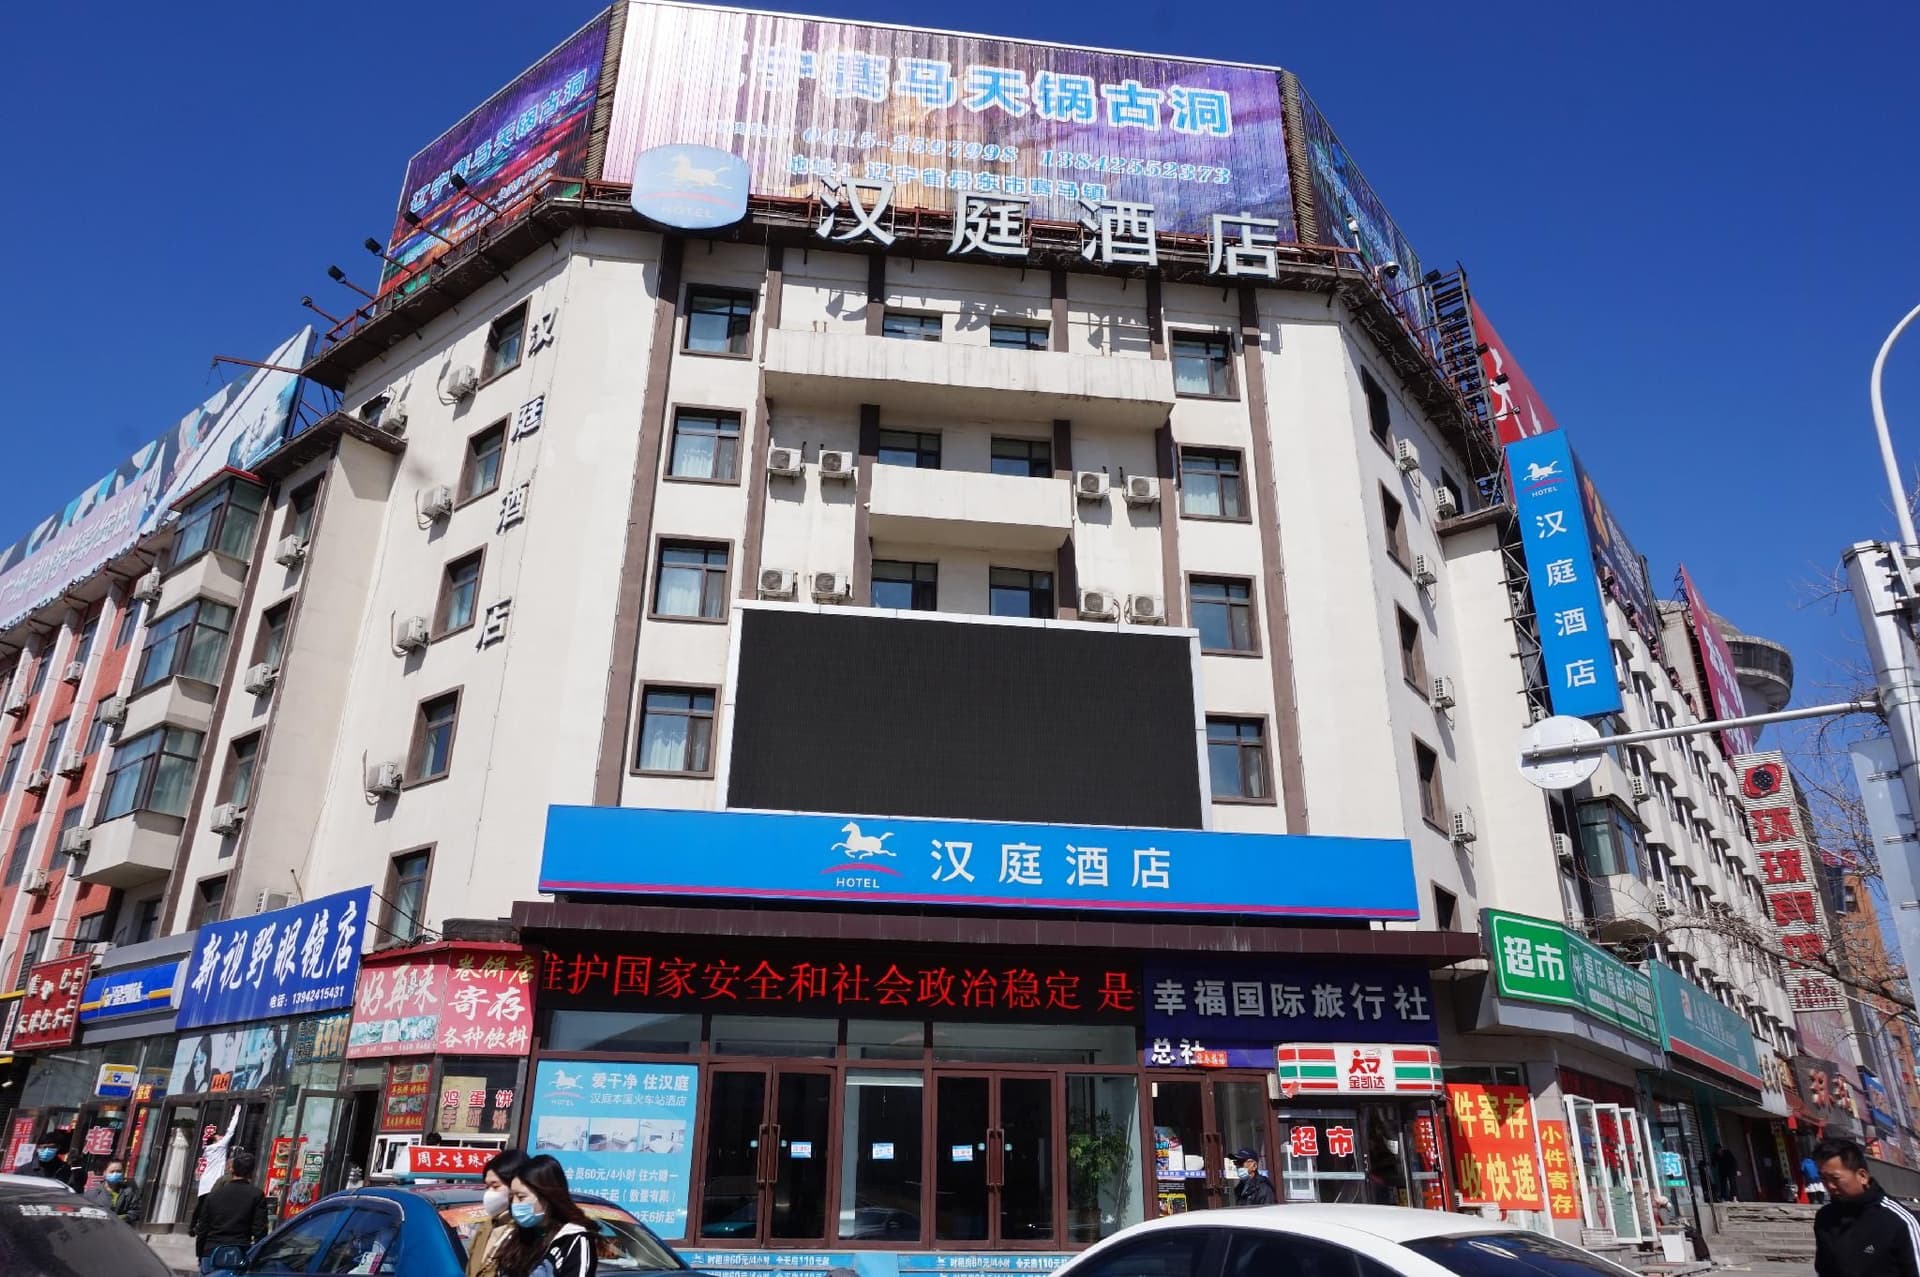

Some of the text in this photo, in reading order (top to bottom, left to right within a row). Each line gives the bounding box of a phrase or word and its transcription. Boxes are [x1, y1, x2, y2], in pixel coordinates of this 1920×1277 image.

[738, 46, 1233, 137] 宁赛马天锅古洞
[815, 175, 1280, 280] 汉庭酒店
[1531, 486, 1558, 497] HOTEL
[1536, 509, 1598, 688] 汉庭酒店
[835, 877, 880, 889] HOTEL
[931, 838, 1171, 889] 汉庭酒店
[192, 900, 358, 1002] 新视野眼镜店
[1503, 935, 1566, 981] 超市
[447, 985, 526, 1022] 寄存
[1153, 979, 1430, 1021] 幸福国际旅行社
[440, 1023, 529, 1051] 各种饮料
[1151, 1037, 1206, 1065] 总社
[442, 1090, 513, 1108] 鸡蛋饼
[592, 1072, 690, 1092] 爱干净 住汉庭
[1290, 1126, 1353, 1158] 超市
[1541, 1125, 1574, 1214] 小件寄存
